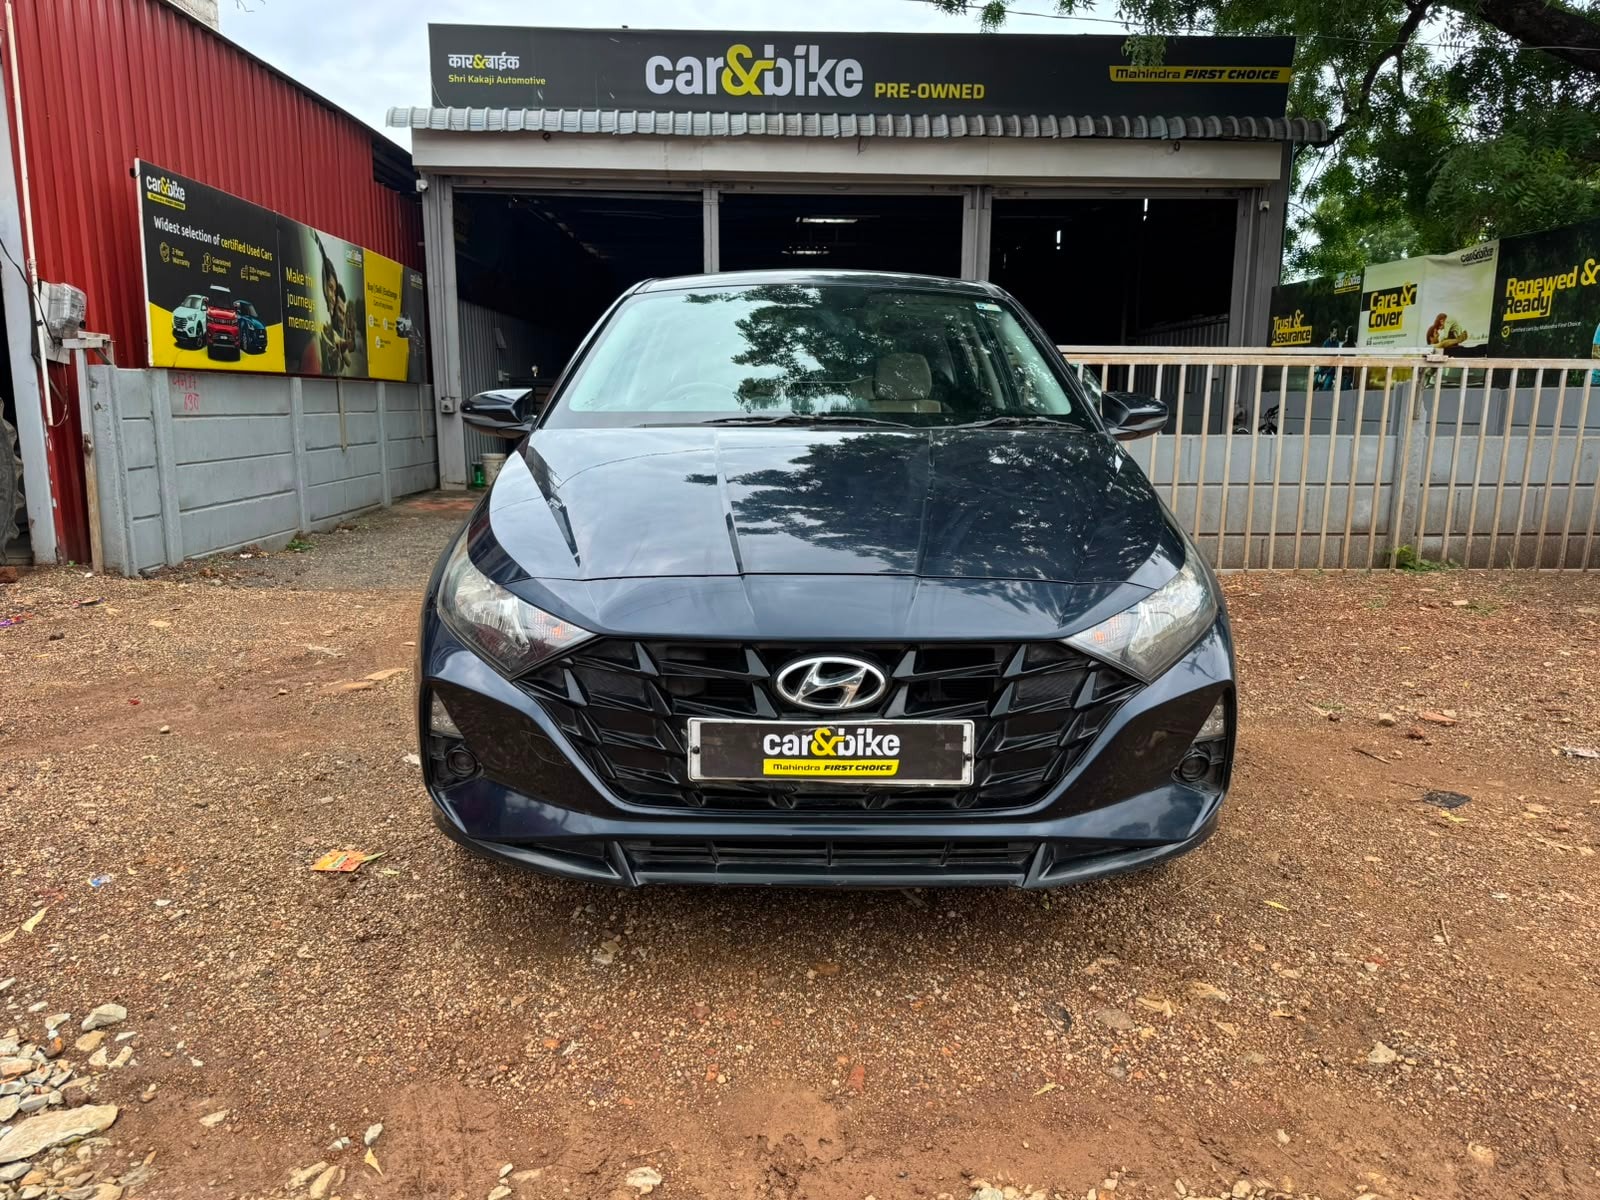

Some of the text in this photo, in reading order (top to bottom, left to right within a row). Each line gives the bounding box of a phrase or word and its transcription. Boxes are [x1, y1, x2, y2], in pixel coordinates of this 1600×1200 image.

[448, 74, 546, 86] Shri Kakaji Automotive
[645, 44, 863, 97] car&bike
[1115, 69, 1280, 80] Mahindra FIRST CHOICE
[874, 82, 985, 99] PRE-OWNED
[146, 175, 186, 201] car&bike
[153, 215, 273, 261] Widest selection of certified Used Cars
[285, 266, 305, 287] Make
[1505, 258, 1600, 297] Renewed &
[1369, 281, 1418, 311] Care &
[1504, 292, 1550, 317] Ready
[1273, 309, 1305, 330] Trust &
[1368, 308, 1403, 329] Cover
[1271, 327, 1311, 344] Assurance
[763, 727, 900, 757] car&bike
[773, 763, 821, 771] Mahindra
